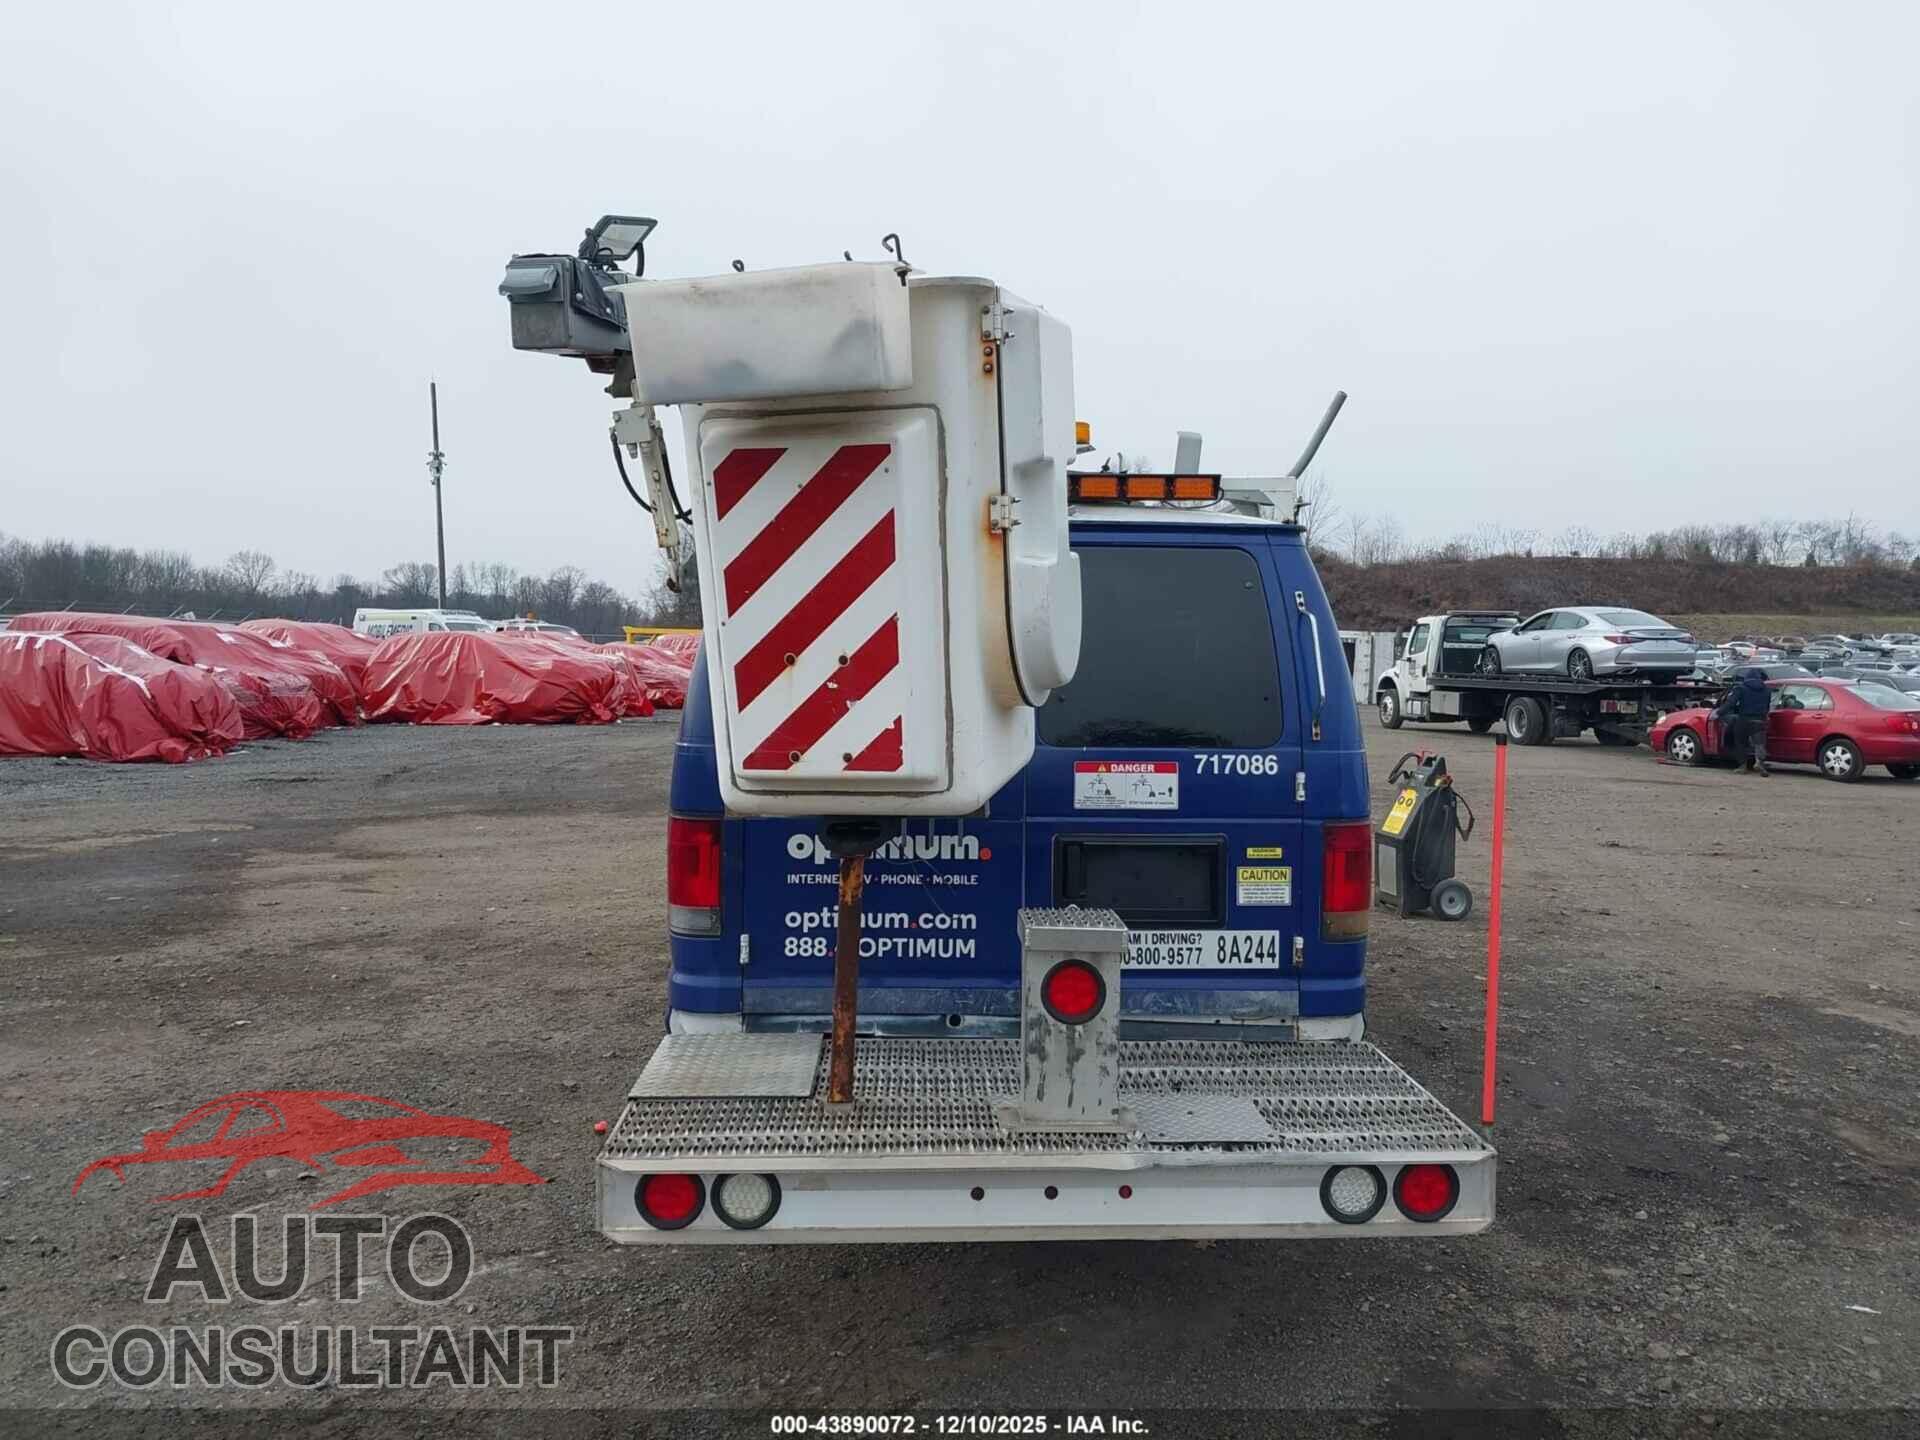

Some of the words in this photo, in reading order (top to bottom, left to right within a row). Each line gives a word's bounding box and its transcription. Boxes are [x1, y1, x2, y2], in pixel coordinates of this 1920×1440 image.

[1110, 764, 1155, 773] DANGER
[1194, 754, 1279, 775] 717086
[787, 874, 841, 885] INTERNE
[881, 874, 924, 885] PHONE
[932, 874, 979, 885] MOBILE
[1241, 870, 1288, 881] CAUTION
[1145, 933, 1149, 944] I
[1151, 933, 1202, 945] DRIVING?
[1217, 935, 1277, 964] 8A244
